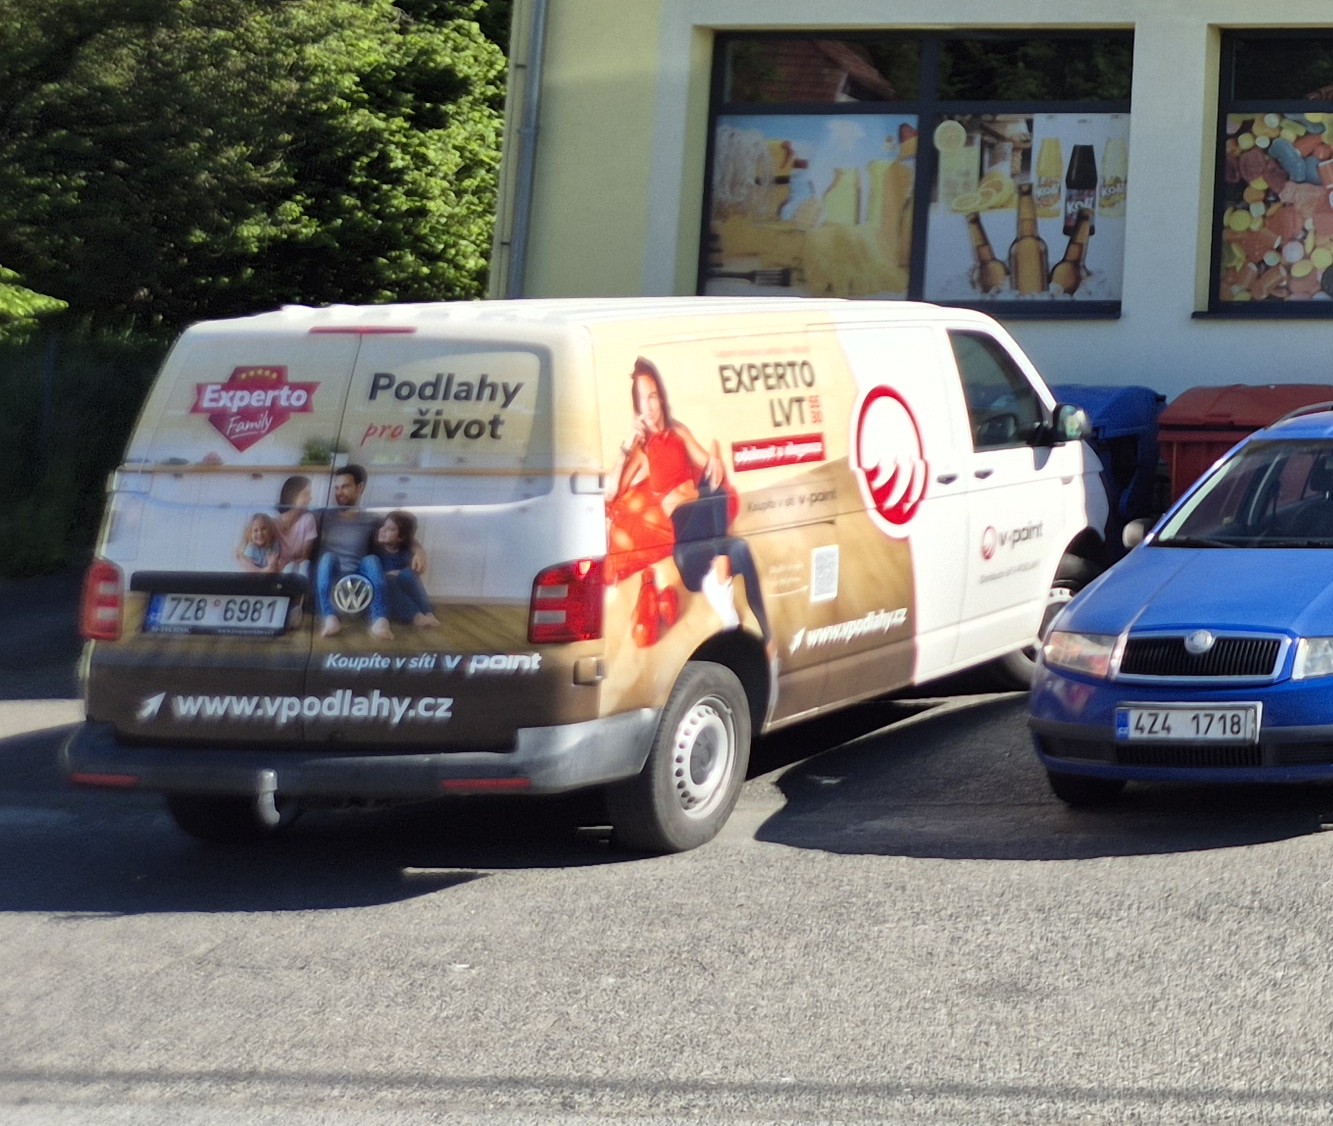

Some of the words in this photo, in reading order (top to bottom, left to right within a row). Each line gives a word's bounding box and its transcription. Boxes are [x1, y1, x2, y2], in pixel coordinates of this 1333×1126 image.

[368, 373, 525, 409] Podlahy
[719, 360, 816, 394] EXPERTO
[202, 384, 308, 412] Experto
[769, 396, 806, 427] LVT
[225, 410, 273, 438] Family
[359, 423, 404, 447] pro
[409, 407, 506, 440] život
[165, 597, 209, 622] 7Z8
[222, 599, 279, 625] 6981
[806, 607, 909, 650] www.vpodlahy.cz
[325, 653, 391, 671] Koupíte
[395, 657, 406, 669] v
[408, 653, 438, 669] síti
[173, 689, 455, 724] www.vpodlahy.cz
[1134, 713, 1171, 735] 4Z4
[1190, 713, 1242, 736] 1718
